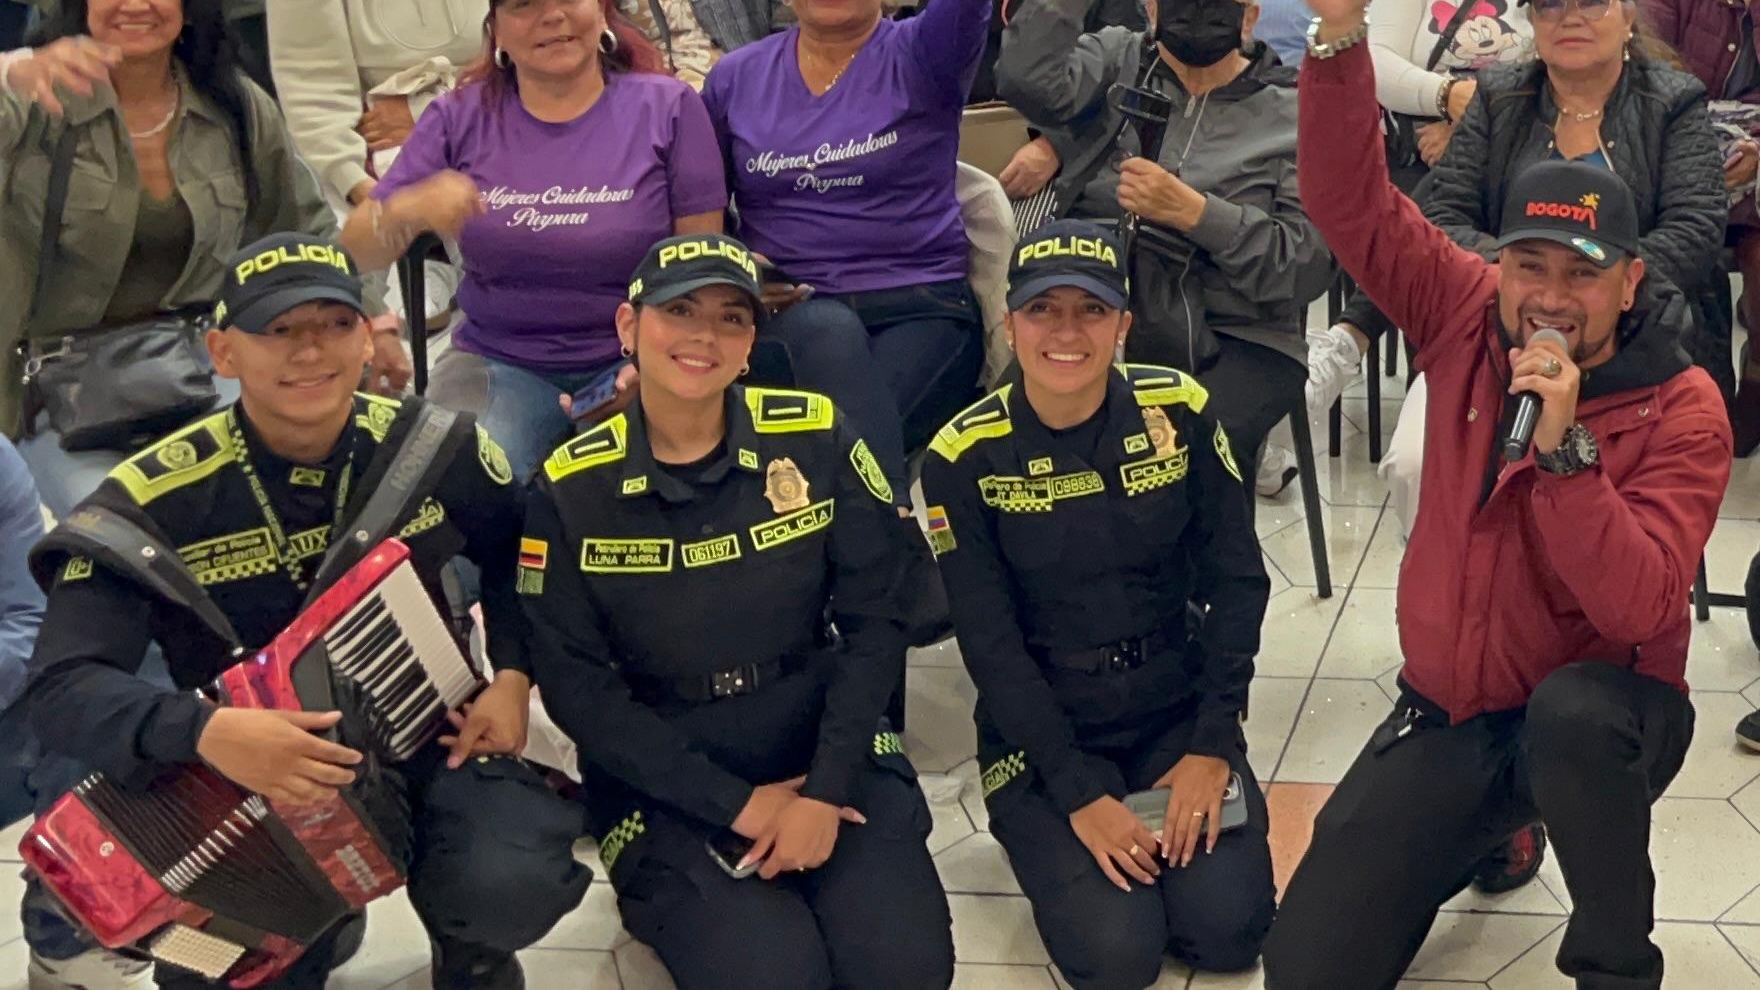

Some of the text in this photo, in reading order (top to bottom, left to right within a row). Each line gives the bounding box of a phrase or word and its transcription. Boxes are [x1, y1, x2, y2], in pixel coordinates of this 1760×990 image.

[746, 130, 898, 177] Mujeres Cuidadoras
[480, 185, 634, 210] Mujeres Cuidadoras
[236, 243, 350, 285] POLICÍA
[659, 241, 757, 282] POLICÍA
[1018, 236, 1117, 268] POLICÍA
[589, 554, 661, 565] LUNA PARRA
[689, 541, 730, 562] 061197
